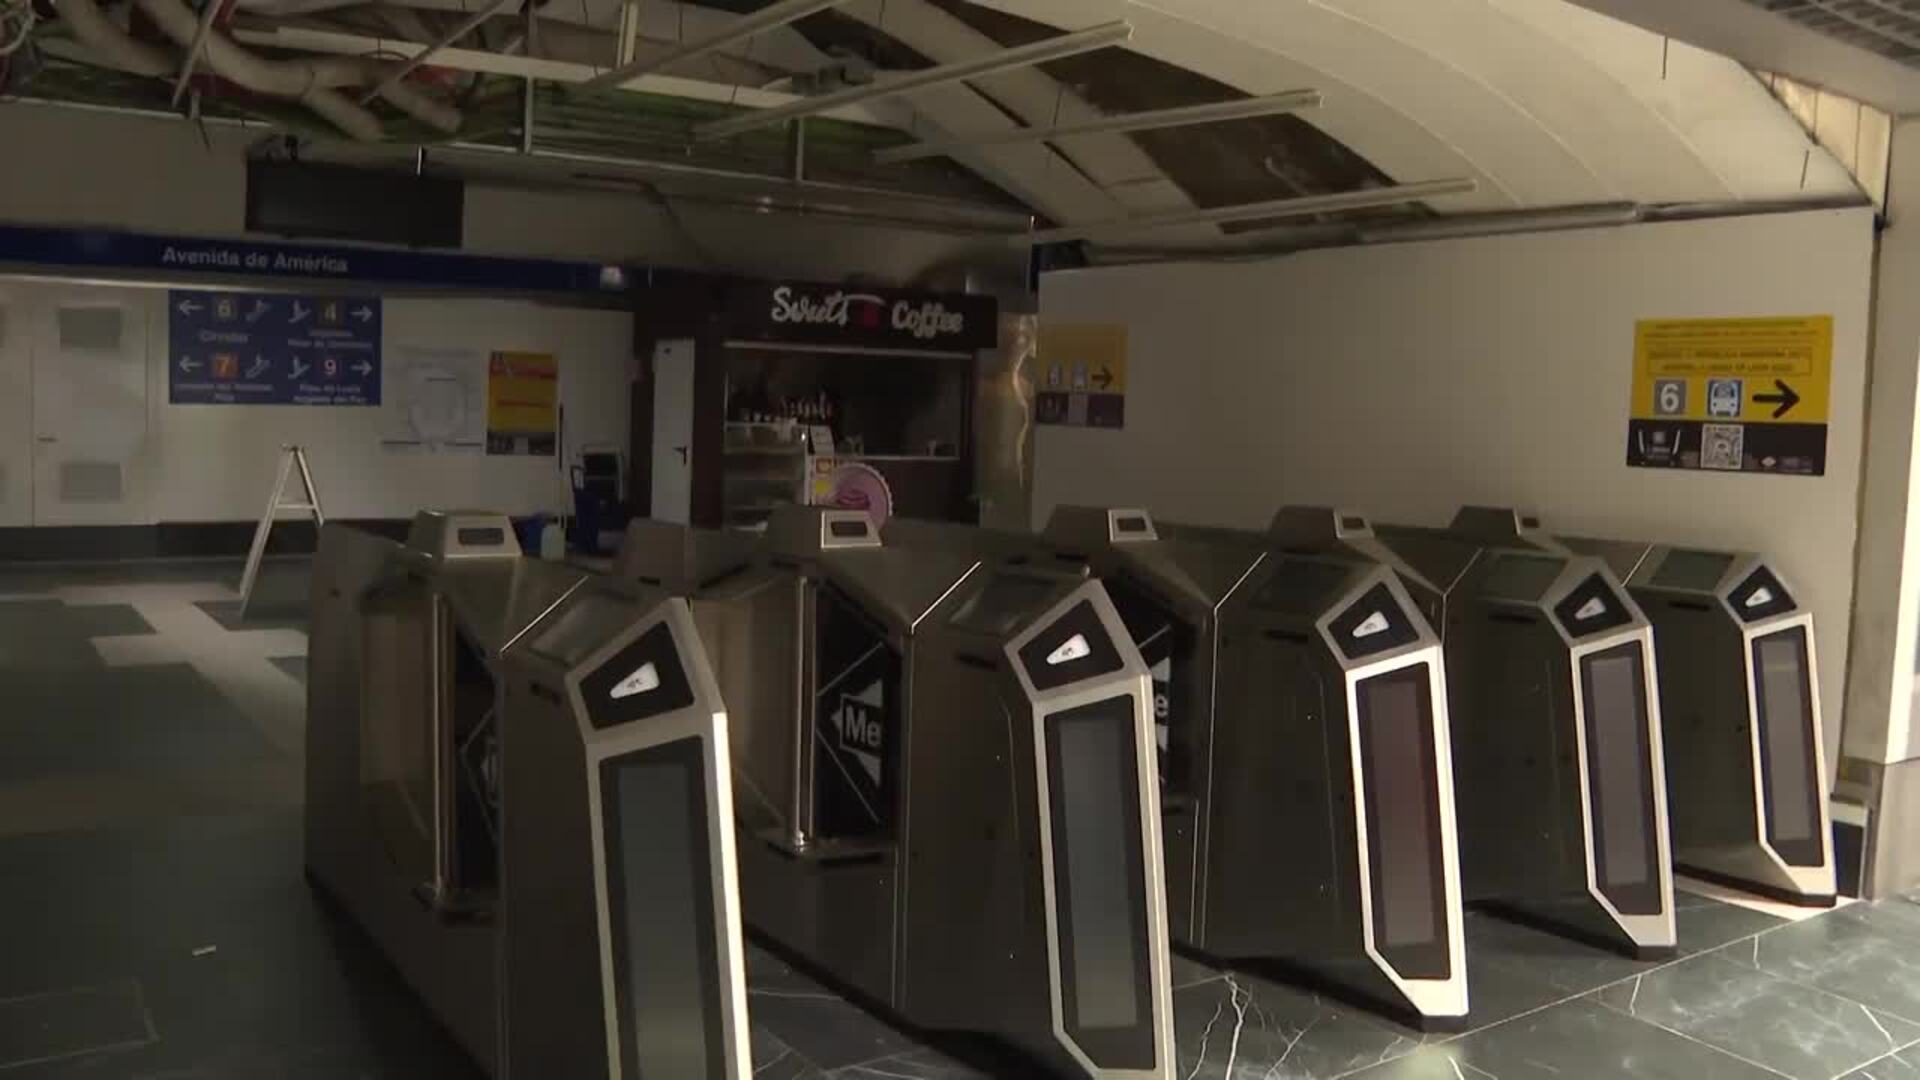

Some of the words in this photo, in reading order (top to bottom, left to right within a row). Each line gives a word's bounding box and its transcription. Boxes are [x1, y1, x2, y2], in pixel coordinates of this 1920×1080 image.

[161, 246, 240, 266] Avenida
[244, 251, 269, 268] de
[273, 252, 349, 273] América
[217, 299, 231, 317] 6
[323, 303, 337, 320] 4
[891, 299, 964, 339] Coffee
[216, 354, 230, 377] 7
[324, 358, 337, 376] 9
[1659, 382, 1680, 413] 6
[844, 706, 883, 747] Me
